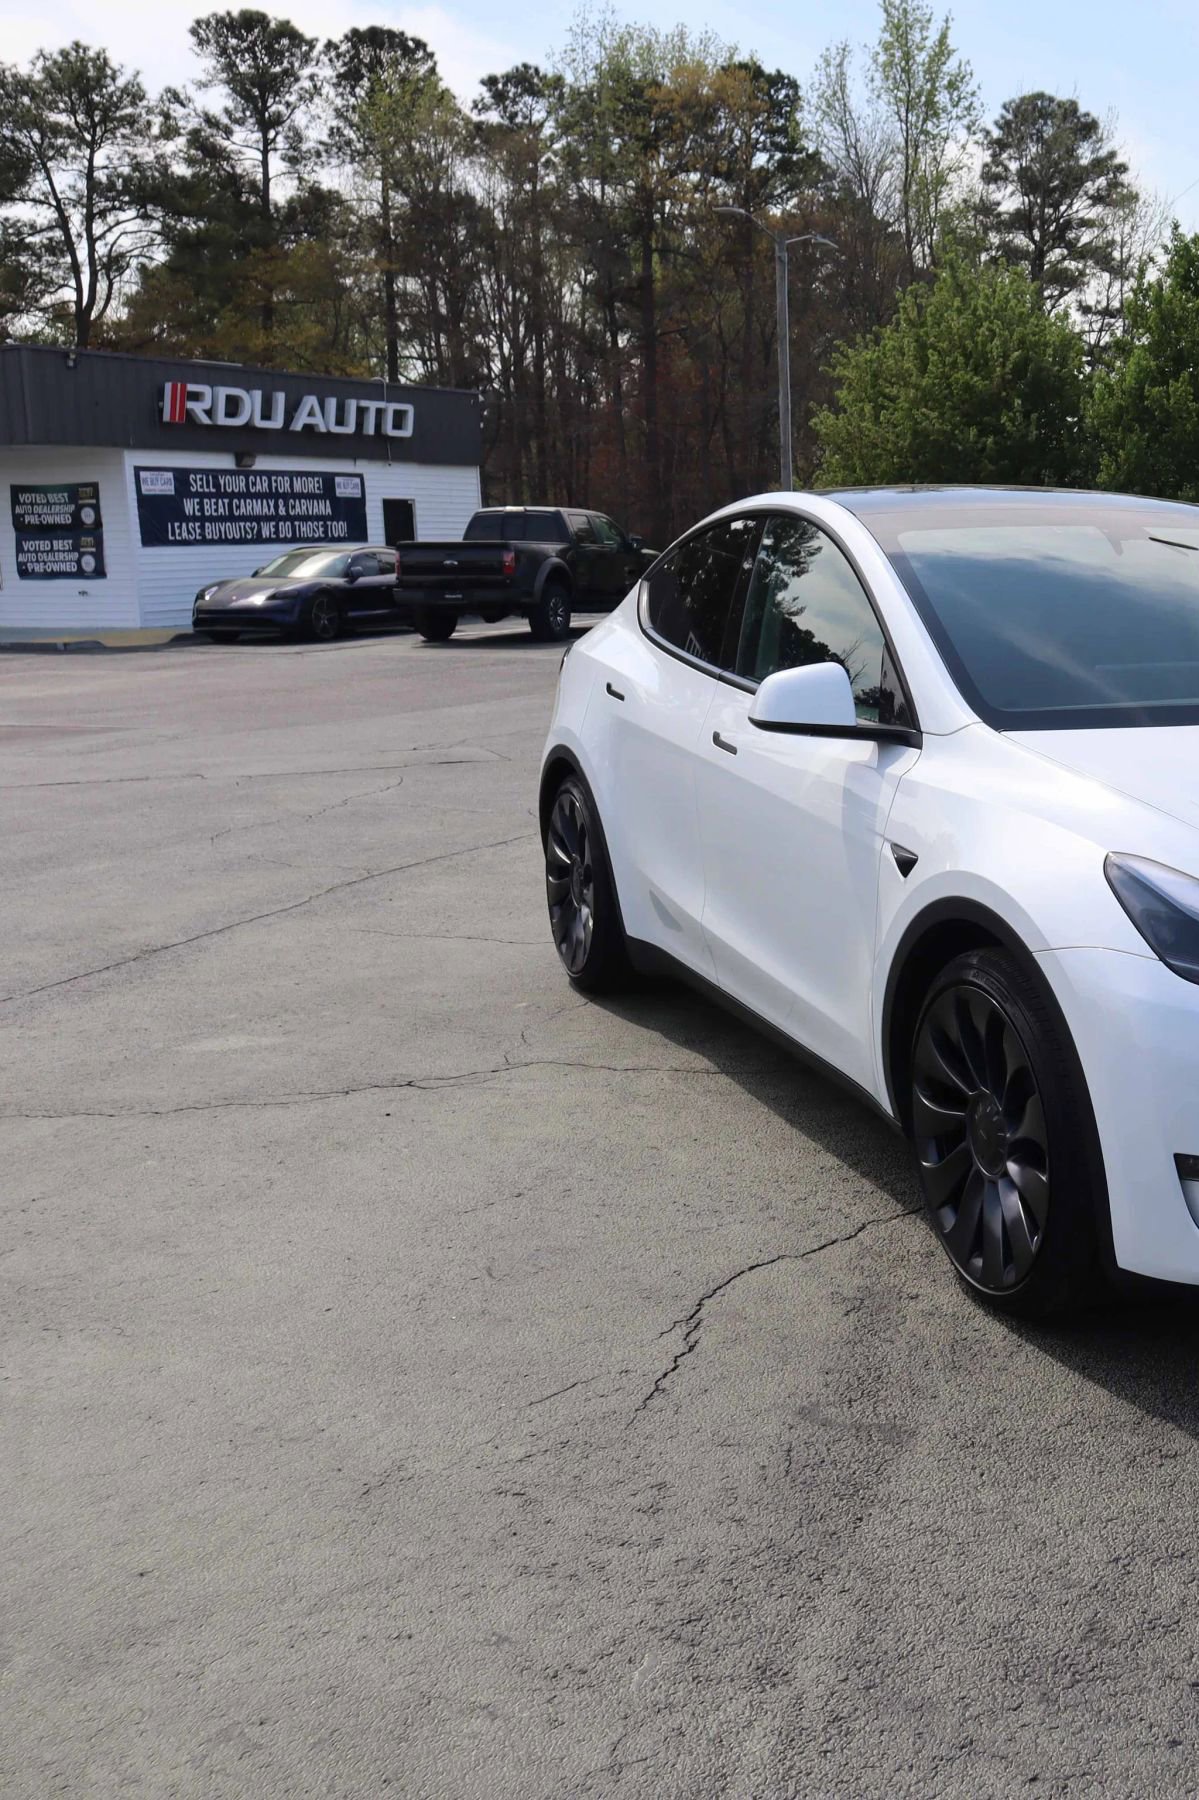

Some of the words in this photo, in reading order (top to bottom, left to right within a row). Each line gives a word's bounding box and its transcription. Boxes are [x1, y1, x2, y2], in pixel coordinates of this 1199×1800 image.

[163, 382, 285, 430] RDU
[289, 395, 415, 438] AUTO
[189, 474, 216, 492] SELL
[219, 475, 246, 493] YOUR
[249, 475, 269, 493] CAR
[271, 476, 291, 493] FOR
[293, 476, 323, 494] MORE!
[18, 493, 47, 504] VOTED
[47, 492, 69, 503] BEST
[15, 505, 32, 514] AUTO
[33, 504, 75, 514] DEALERSHIP
[183, 498, 201, 516] WE
[203, 498, 229, 516] BEAT
[232, 499, 276, 516] CARMAX
[278, 499, 287, 516] &
[288, 499, 332, 516] CARVANA
[24, 514, 72, 524] PRE-OWNED
[168, 522, 201, 540] LEASE
[205, 522, 258, 540] BUYOUTS?
[261, 521, 276, 539] WE
[278, 521, 292, 538] DO
[294, 521, 325, 538] THOSE
[326, 521, 348, 537] TOO!
[22, 541, 51, 551] VOTED
[52, 540, 73, 550] BEST
[18, 553, 36, 562] AUTO
[38, 552, 79, 562] DEALERSHIP
[27, 562, 77, 573] PRE-OWNED
